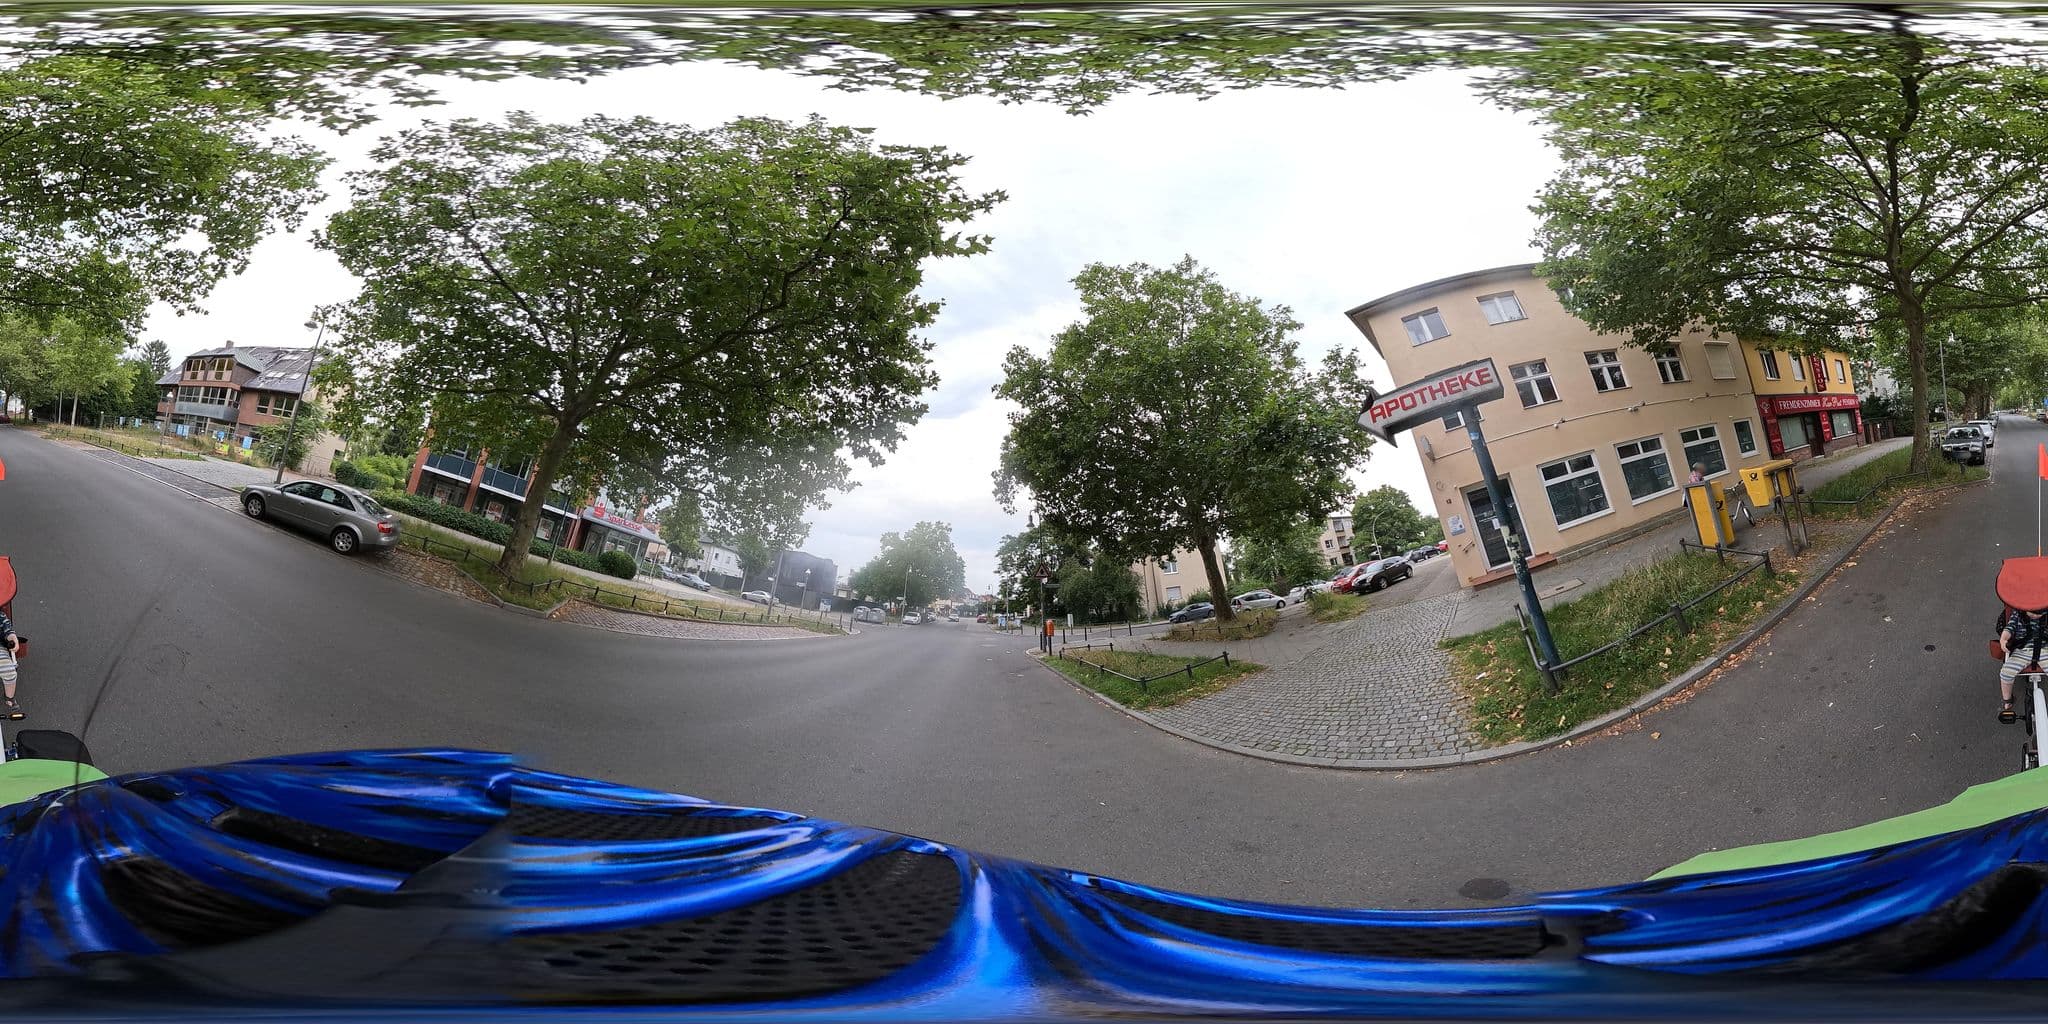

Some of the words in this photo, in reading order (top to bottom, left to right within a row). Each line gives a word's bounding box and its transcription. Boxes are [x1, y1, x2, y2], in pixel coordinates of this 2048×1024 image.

[1369, 367, 1493, 424] APOTHEKE
[1779, 400, 1821, 409] FREMDENZIMMER
[608, 513, 642, 532] Sparkasse
